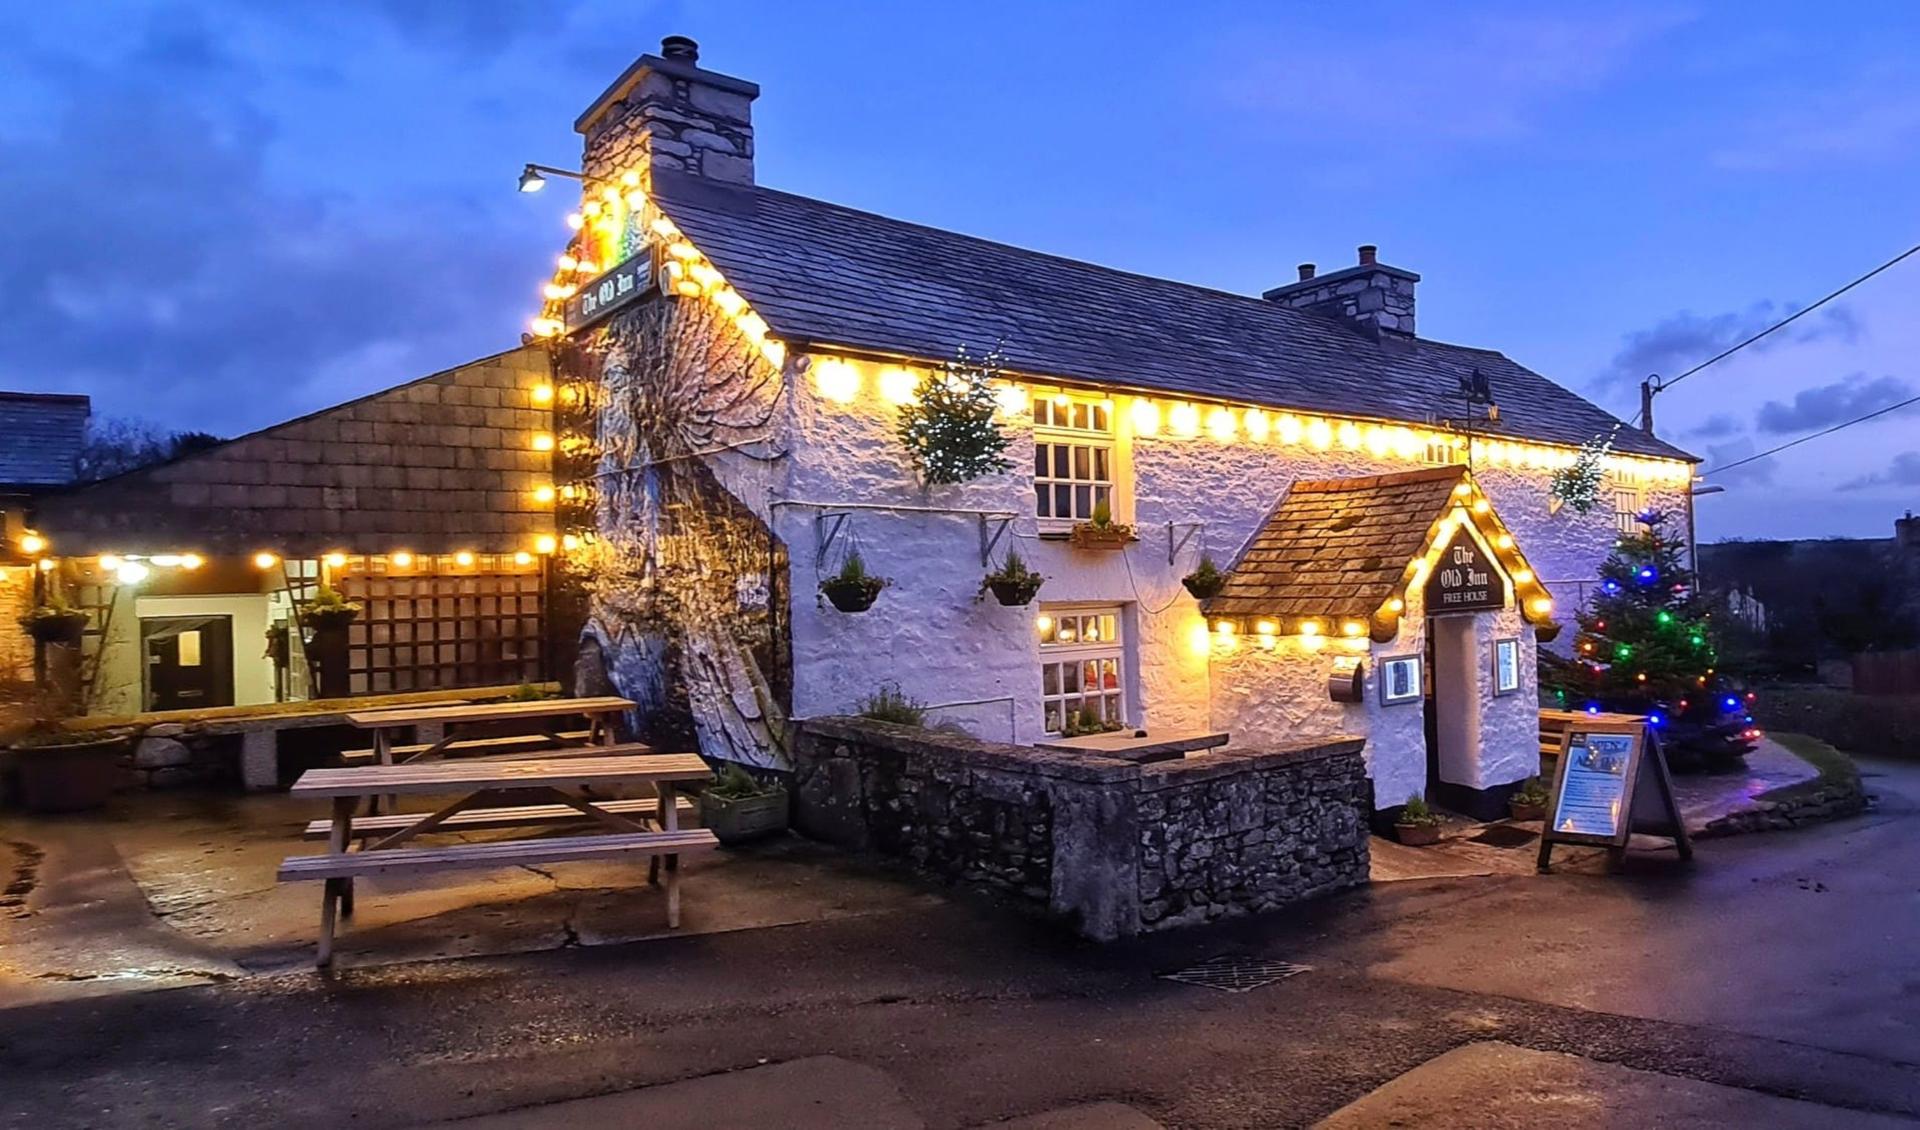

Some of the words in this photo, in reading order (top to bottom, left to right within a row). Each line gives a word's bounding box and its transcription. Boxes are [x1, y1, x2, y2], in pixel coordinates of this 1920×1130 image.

[583, 292, 597, 315] The
[599, 280, 615, 305] Old
[617, 273, 633, 296] Inn
[1453, 546, 1475, 565] The
[1440, 568, 1463, 589] Old
[1466, 567, 1488, 587] Inn
[1443, 591, 1462, 604] FREE
[1463, 590, 1488, 602] HOUSE
